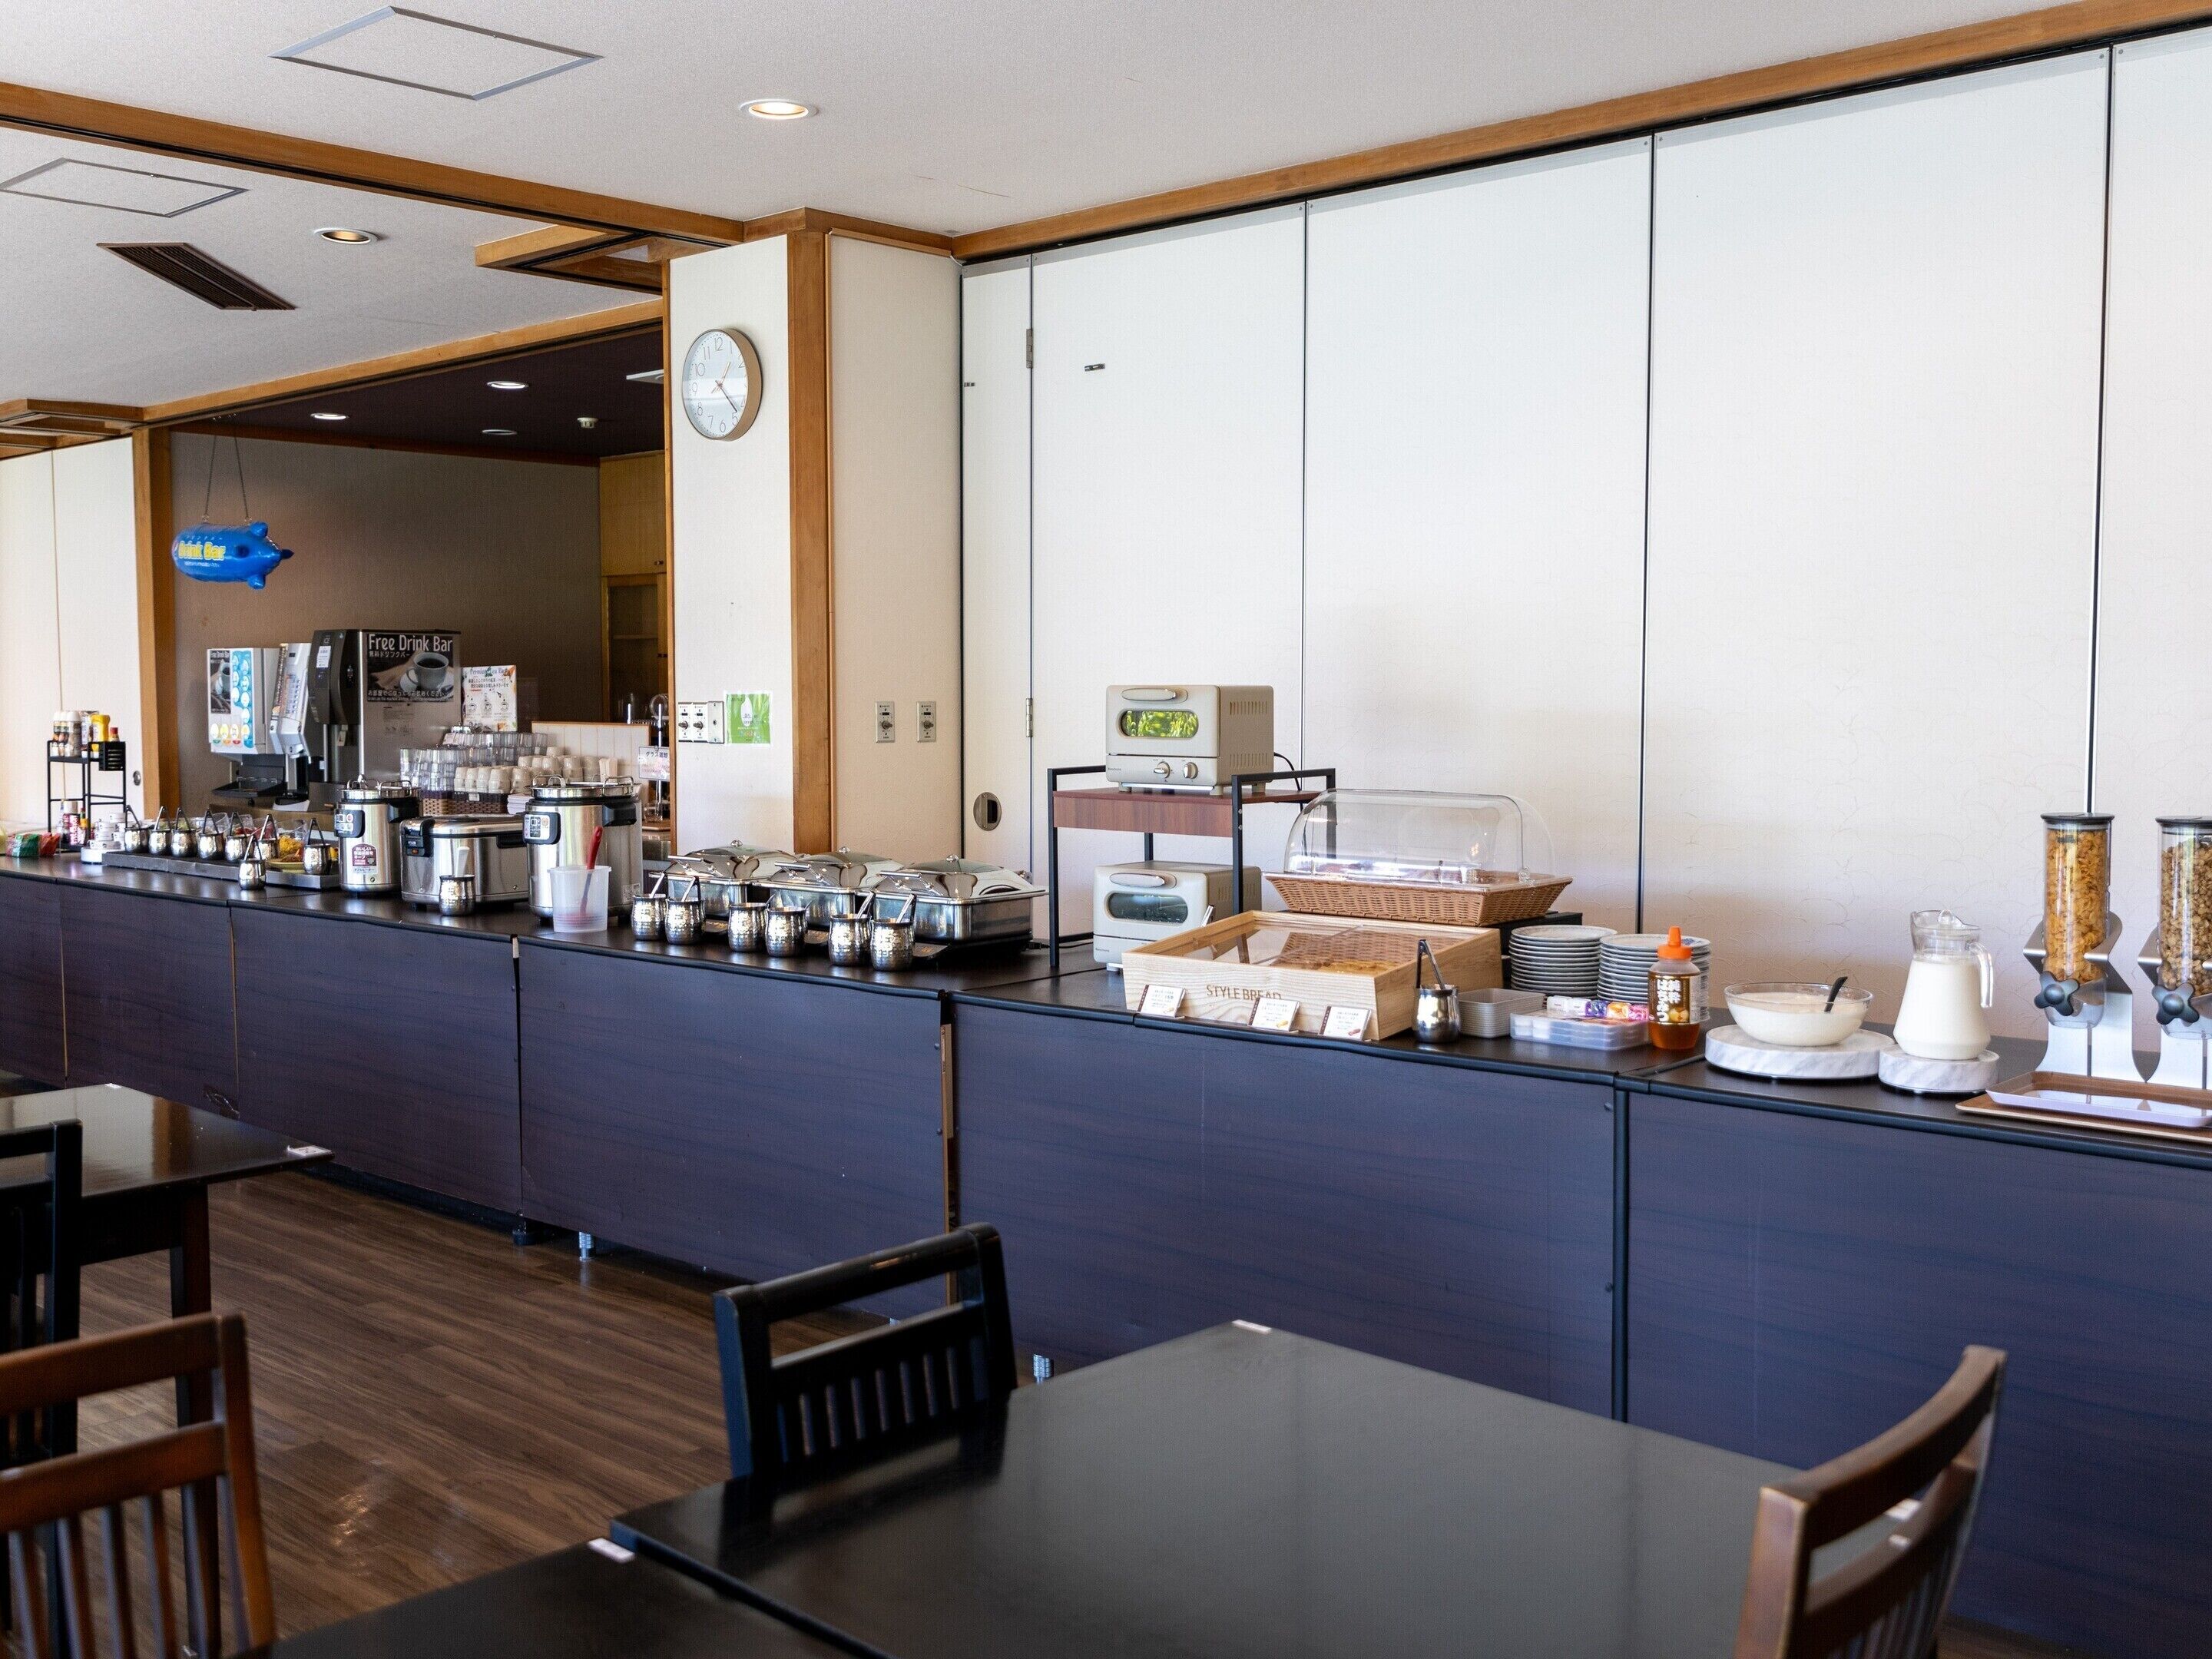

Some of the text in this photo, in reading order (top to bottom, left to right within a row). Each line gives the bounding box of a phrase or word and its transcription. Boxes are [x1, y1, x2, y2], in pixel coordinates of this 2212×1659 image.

[714, 337, 724, 351] 12
[703, 346, 710, 360] 11
[694, 363, 705, 376] 10
[692, 382, 697, 396] 9
[697, 402, 704, 416] 8
[707, 415, 714, 429] 7
[719, 419, 726, 432] 6
[731, 412, 738, 426] 5
[178, 541, 226, 561] Drink Bar
[369, 634, 453, 652] Free Drink Bar
[1206, 985, 1240, 999] STYLE
